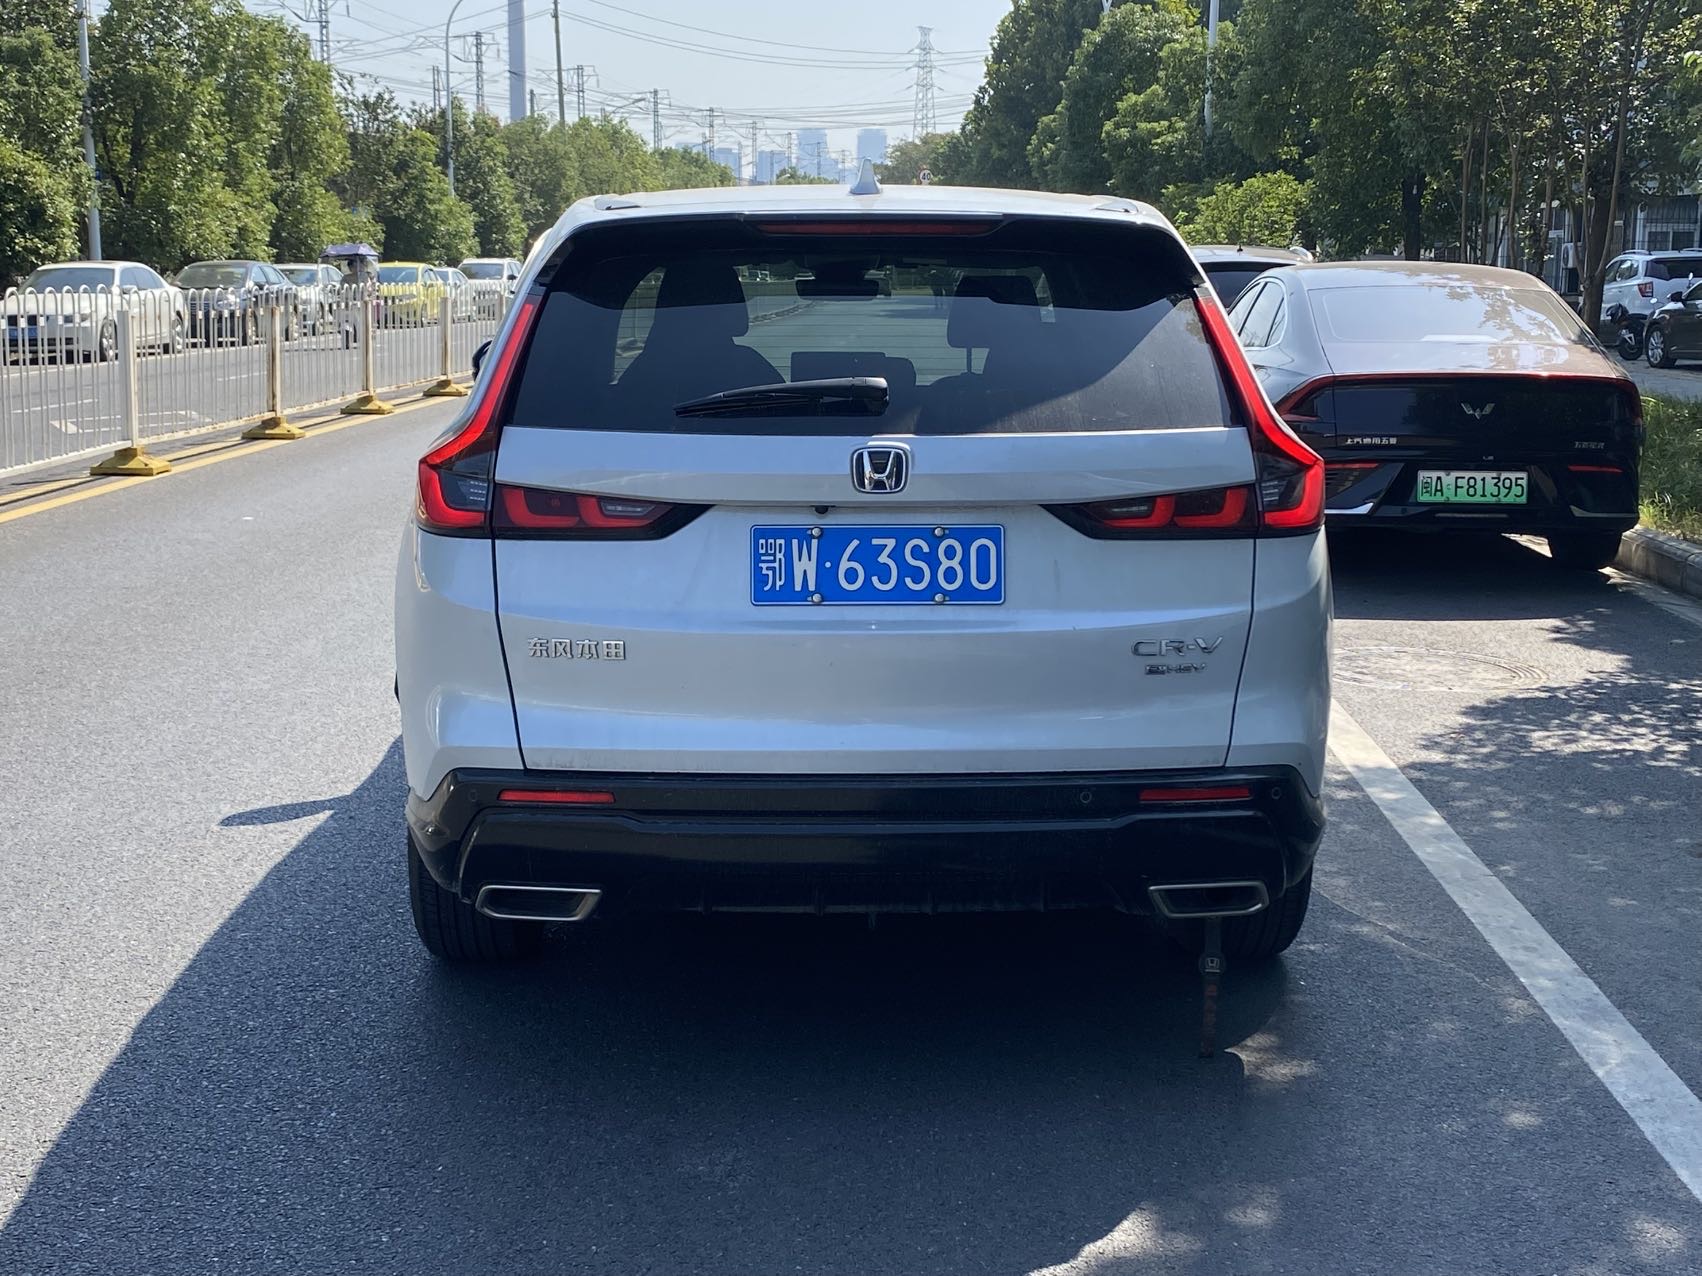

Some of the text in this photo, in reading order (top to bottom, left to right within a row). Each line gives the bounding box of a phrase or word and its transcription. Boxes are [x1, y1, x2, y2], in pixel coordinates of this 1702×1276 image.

[528, 637, 626, 660] 东风本田
[1132, 636, 1224, 656] CR-V
